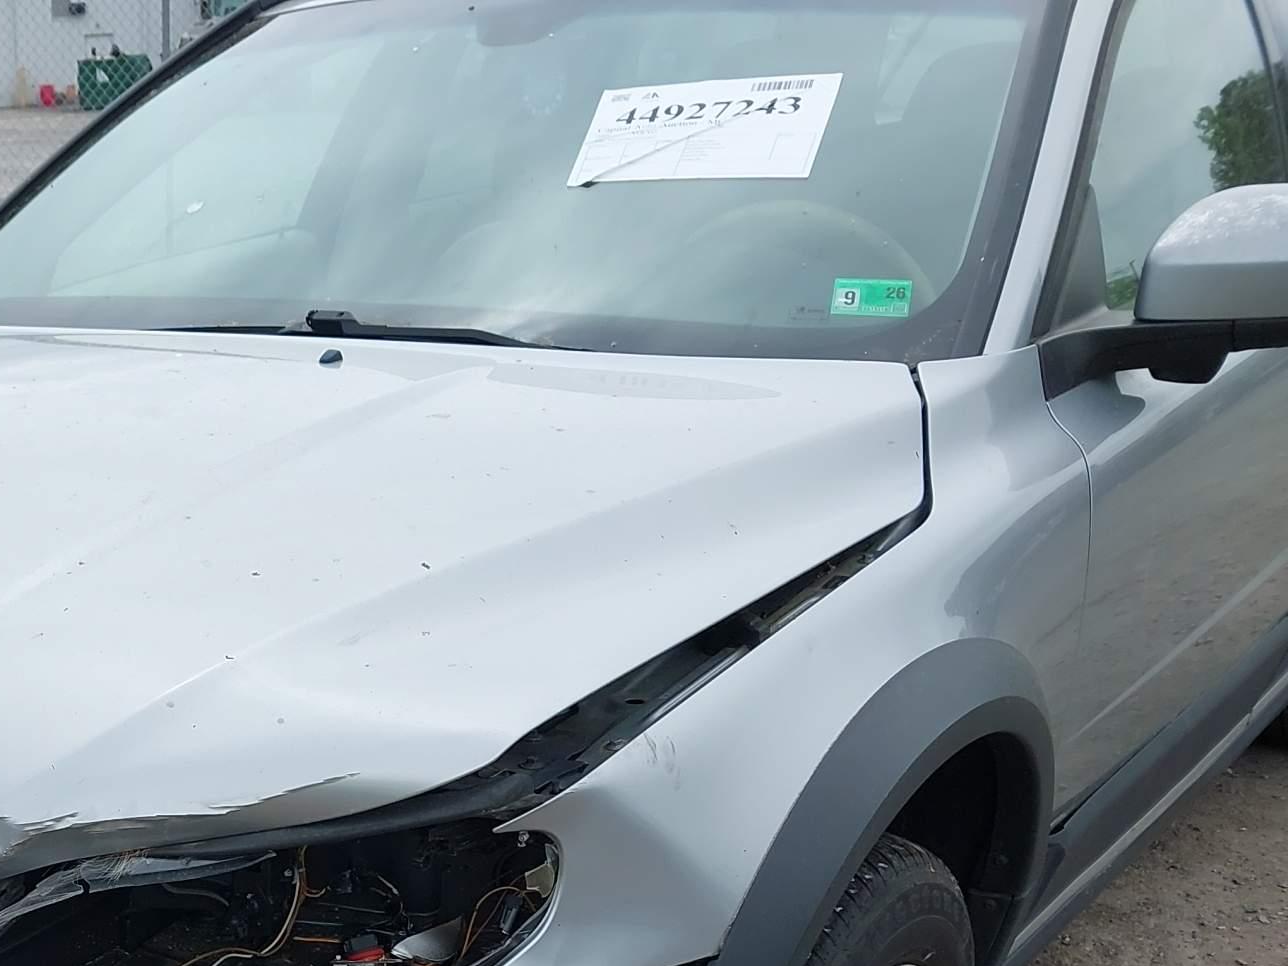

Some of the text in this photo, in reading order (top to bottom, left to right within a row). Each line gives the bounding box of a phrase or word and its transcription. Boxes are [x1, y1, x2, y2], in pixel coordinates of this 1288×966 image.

[615, 96, 802, 125] 44927243
[843, 290, 857, 306] 9
[885, 286, 906, 300] 26
